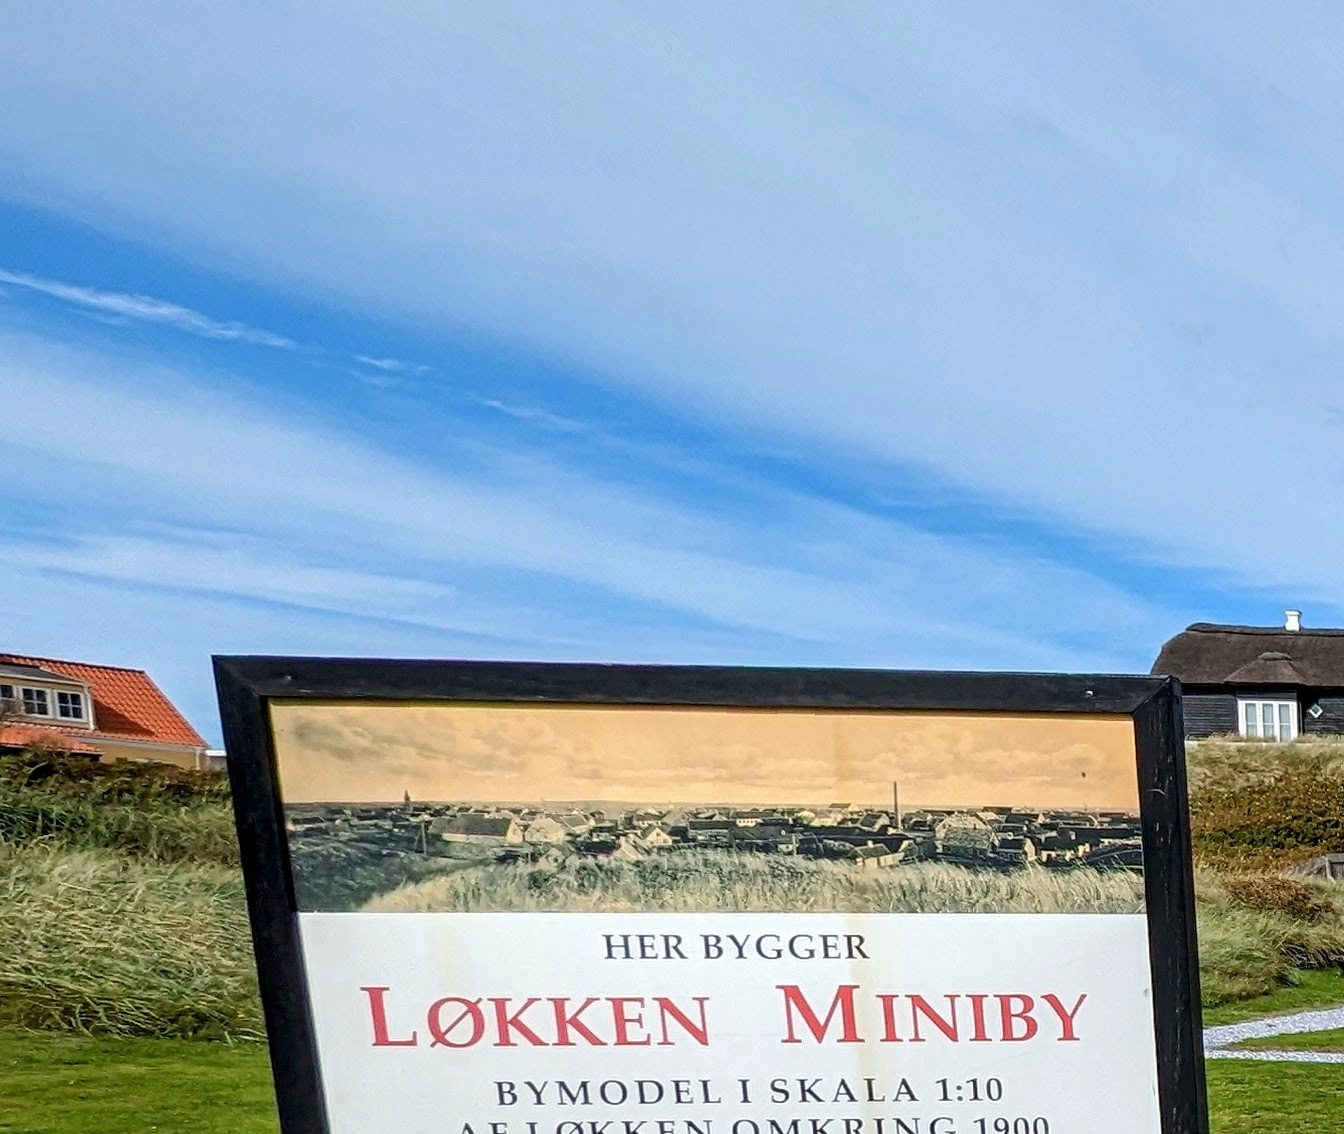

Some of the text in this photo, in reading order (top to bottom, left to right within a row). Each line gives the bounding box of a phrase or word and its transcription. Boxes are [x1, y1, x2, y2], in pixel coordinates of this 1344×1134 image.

[602, 934, 870, 960] HER BYGGER
[360, 985, 1087, 1048] LØKKEN MINIBY
[494, 1078, 1002, 1106] BYMODEL I SKALA 1:10
